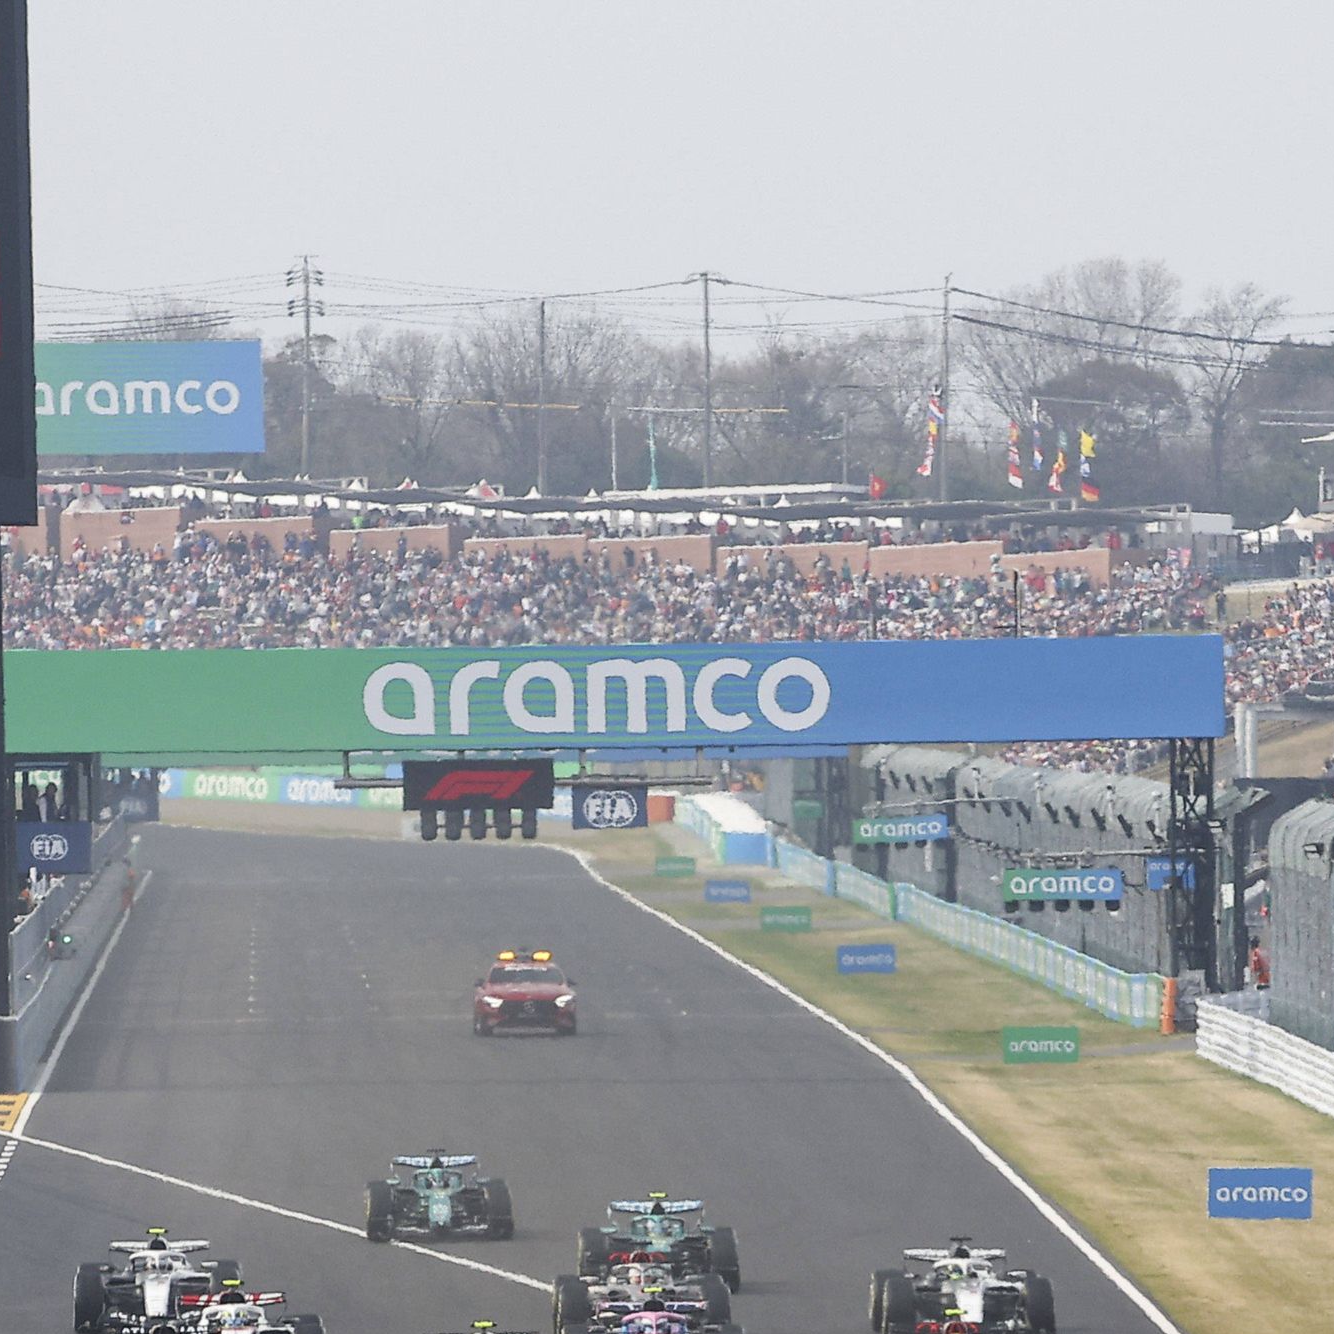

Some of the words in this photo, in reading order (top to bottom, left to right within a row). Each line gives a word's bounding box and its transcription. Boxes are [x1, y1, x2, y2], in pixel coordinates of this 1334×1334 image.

[363, 657, 831, 735] aramco
[194, 774, 268, 800] aramco
[586, 796, 635, 822] FIA
[860, 822, 942, 837] aramco
[33, 838, 66, 857] FIA
[1010, 875, 1115, 894] aramco
[1010, 1039, 1075, 1053] aramco
[1216, 1186, 1308, 1203] aramco
